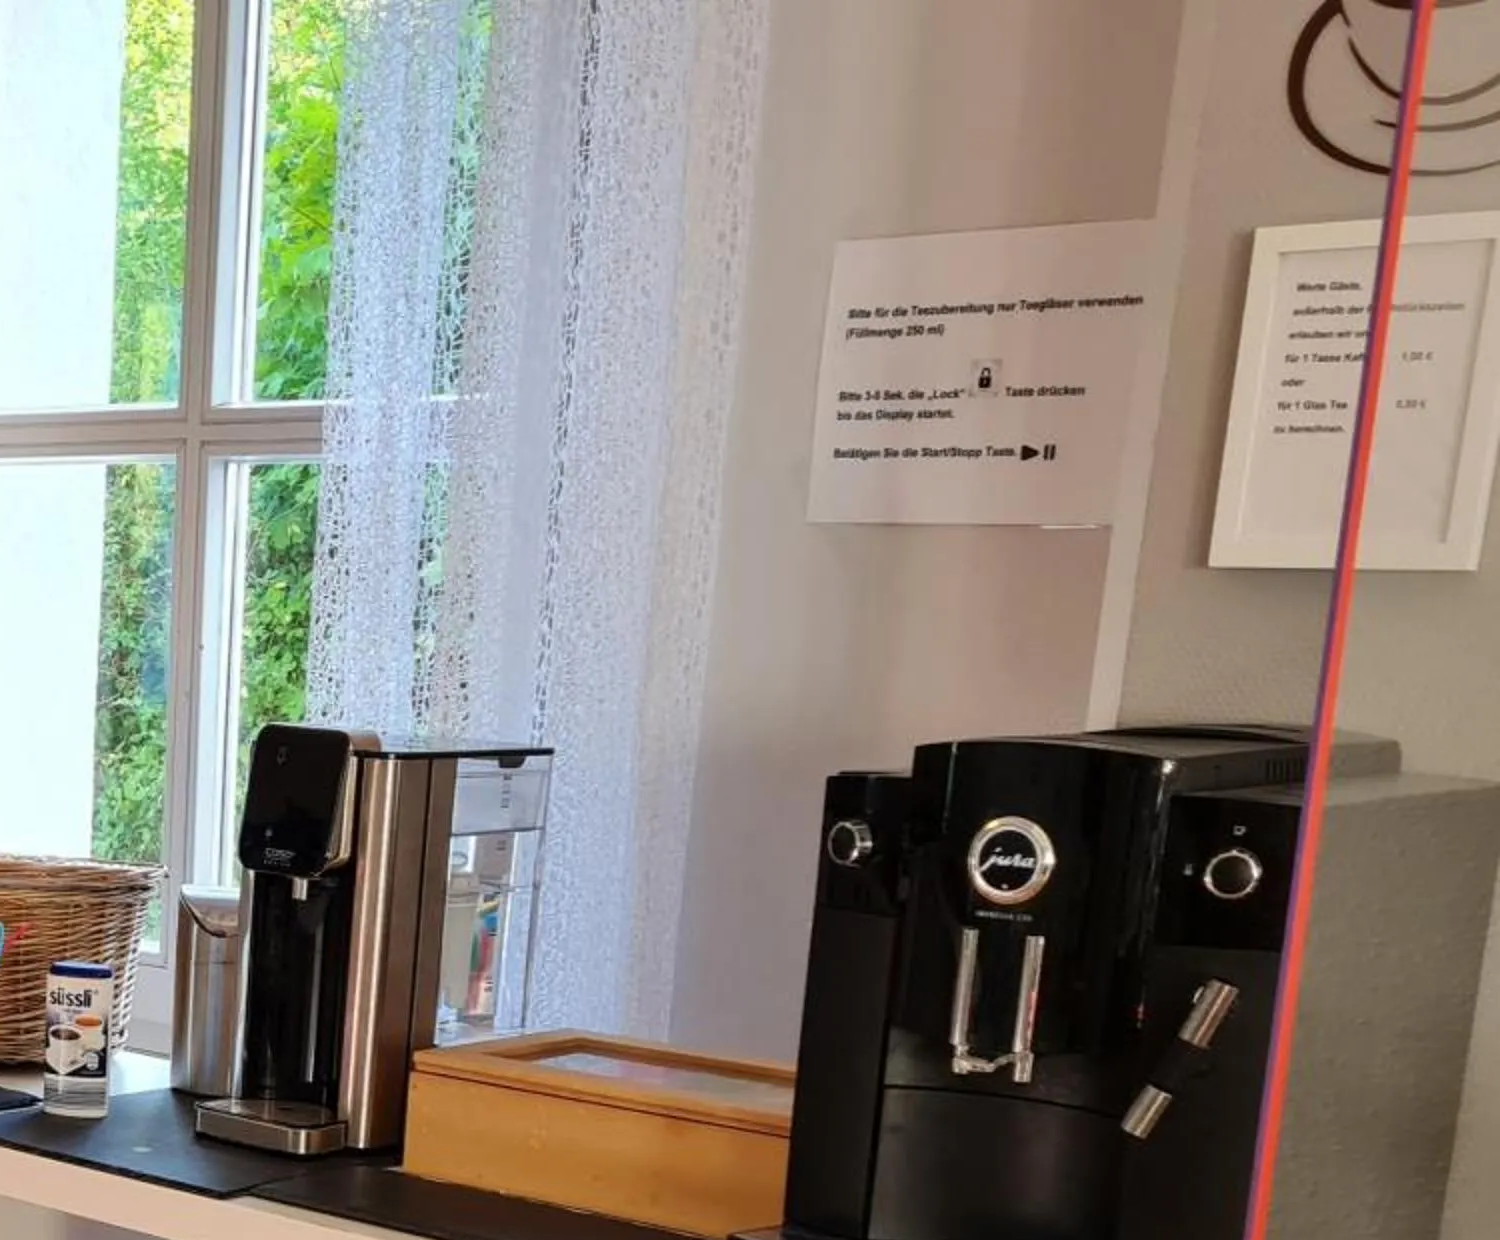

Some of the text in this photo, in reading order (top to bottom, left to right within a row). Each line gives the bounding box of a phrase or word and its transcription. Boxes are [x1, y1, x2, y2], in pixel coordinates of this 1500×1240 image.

[874, 307, 889, 318] für
[891, 306, 908, 317] die
[906, 325, 925, 337] 250
[839, 390, 862, 401] Bitte
[908, 388, 925, 400] die
[1036, 385, 1086, 397] drücken
[902, 447, 918, 459] die
